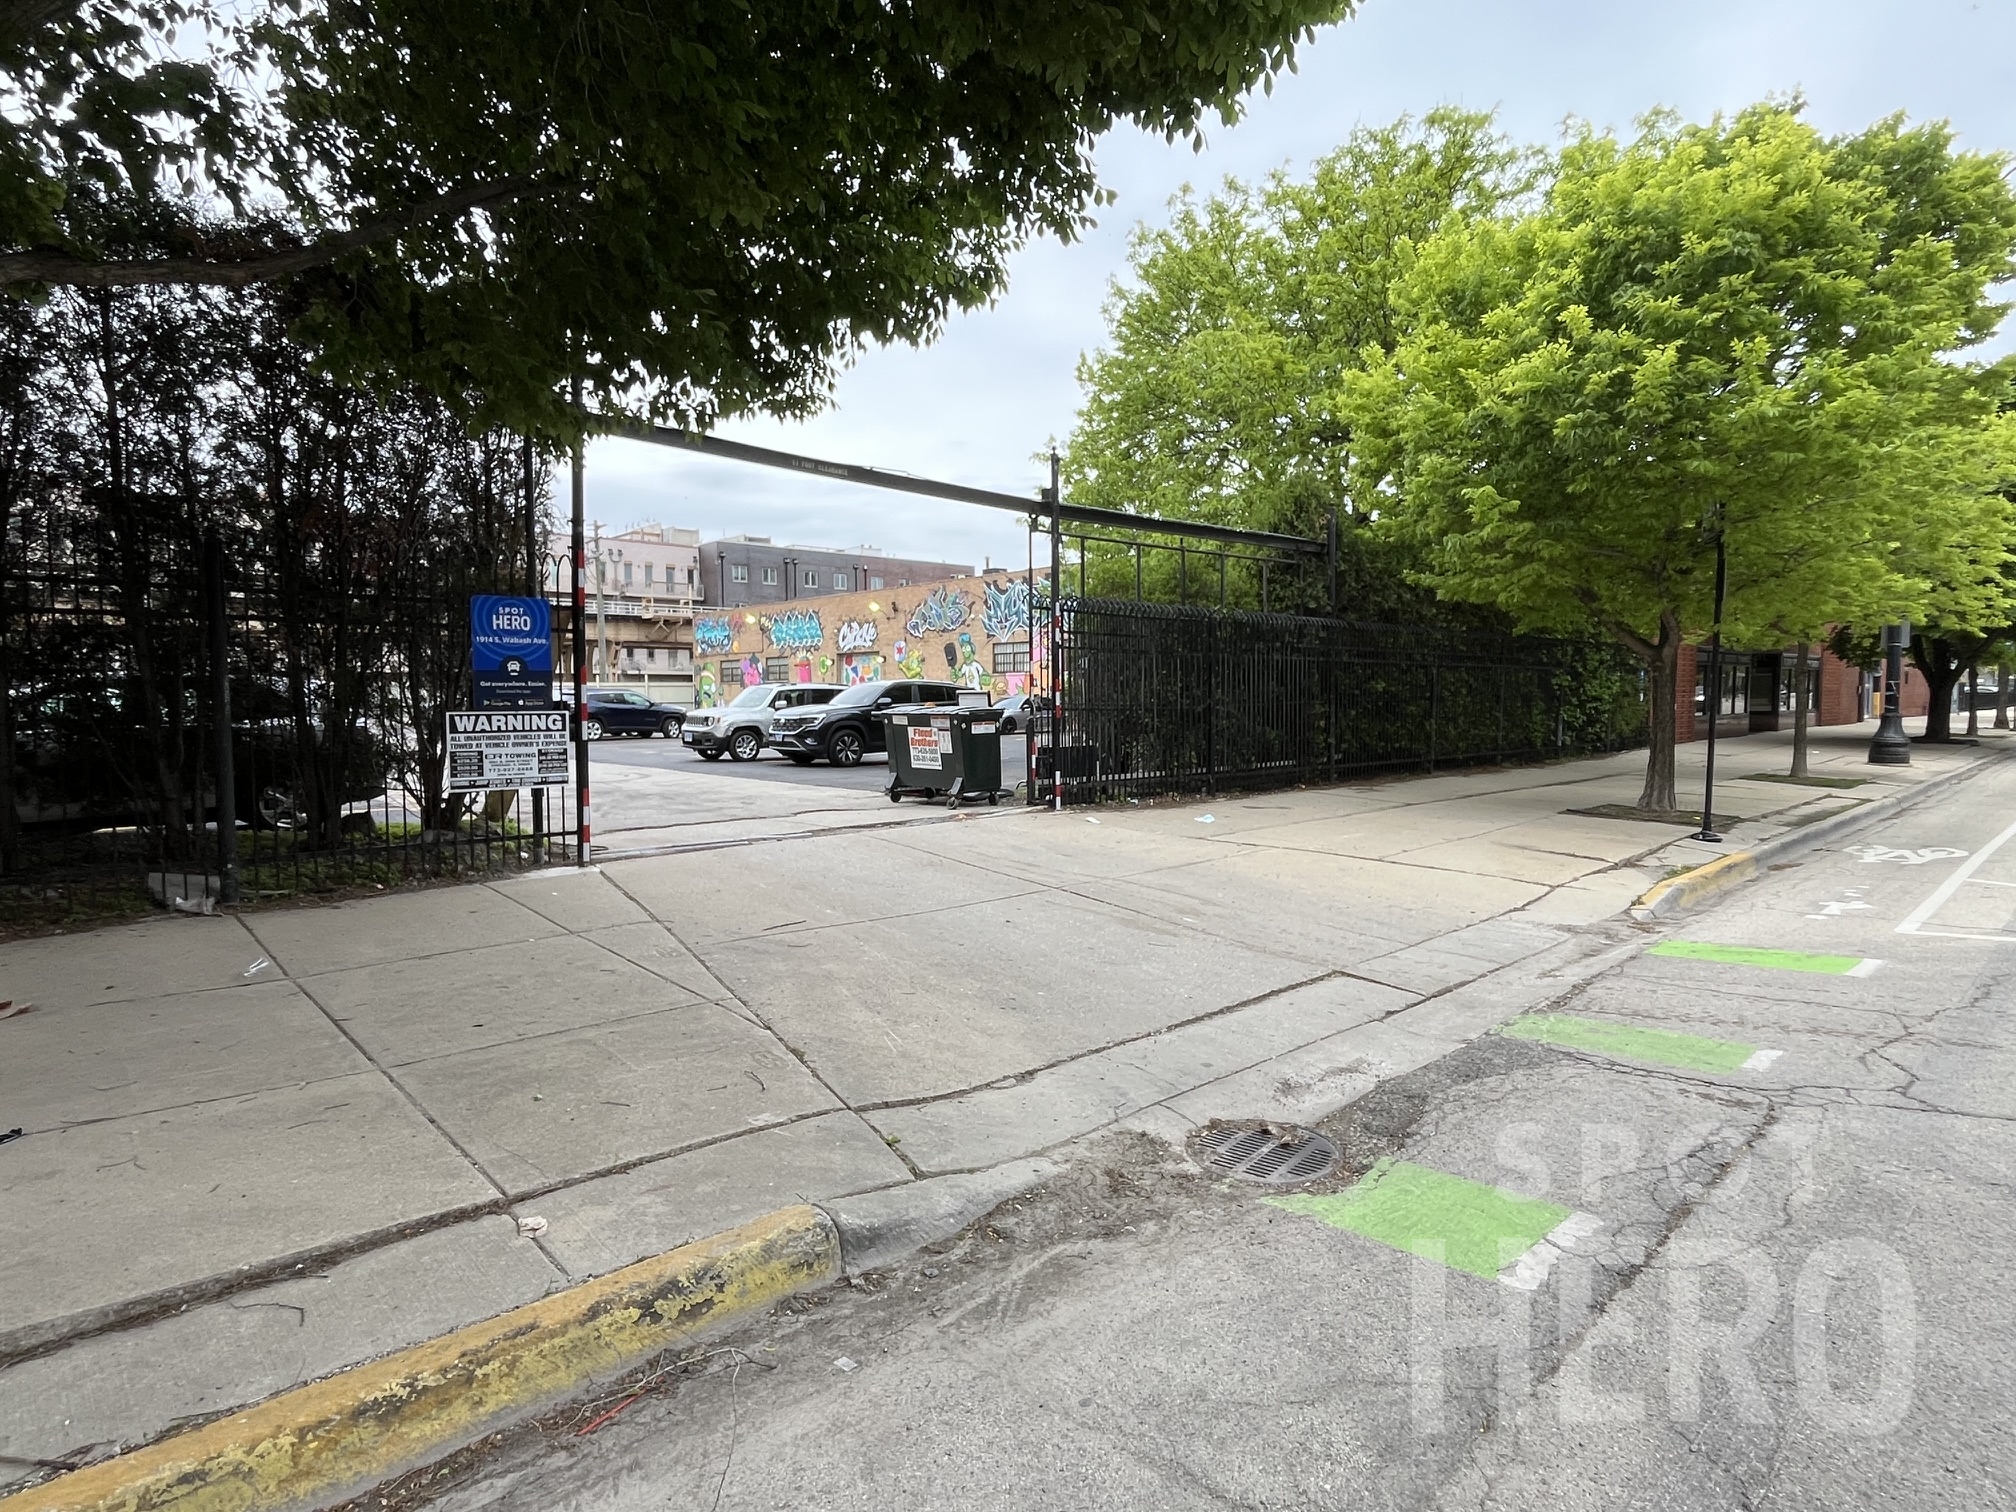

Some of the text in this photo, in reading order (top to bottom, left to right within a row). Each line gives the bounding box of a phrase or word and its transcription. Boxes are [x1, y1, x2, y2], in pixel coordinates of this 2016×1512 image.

[493, 614, 531, 631] HERO
[502, 636, 532, 644] Wabash
[532, 637, 549, 645] Ave.
[454, 714, 562, 732] WARNING
[463, 734, 511, 742] UNAUTHORIZED
[913, 727, 933, 738] Flood
[911, 736, 938, 747] Brothers
